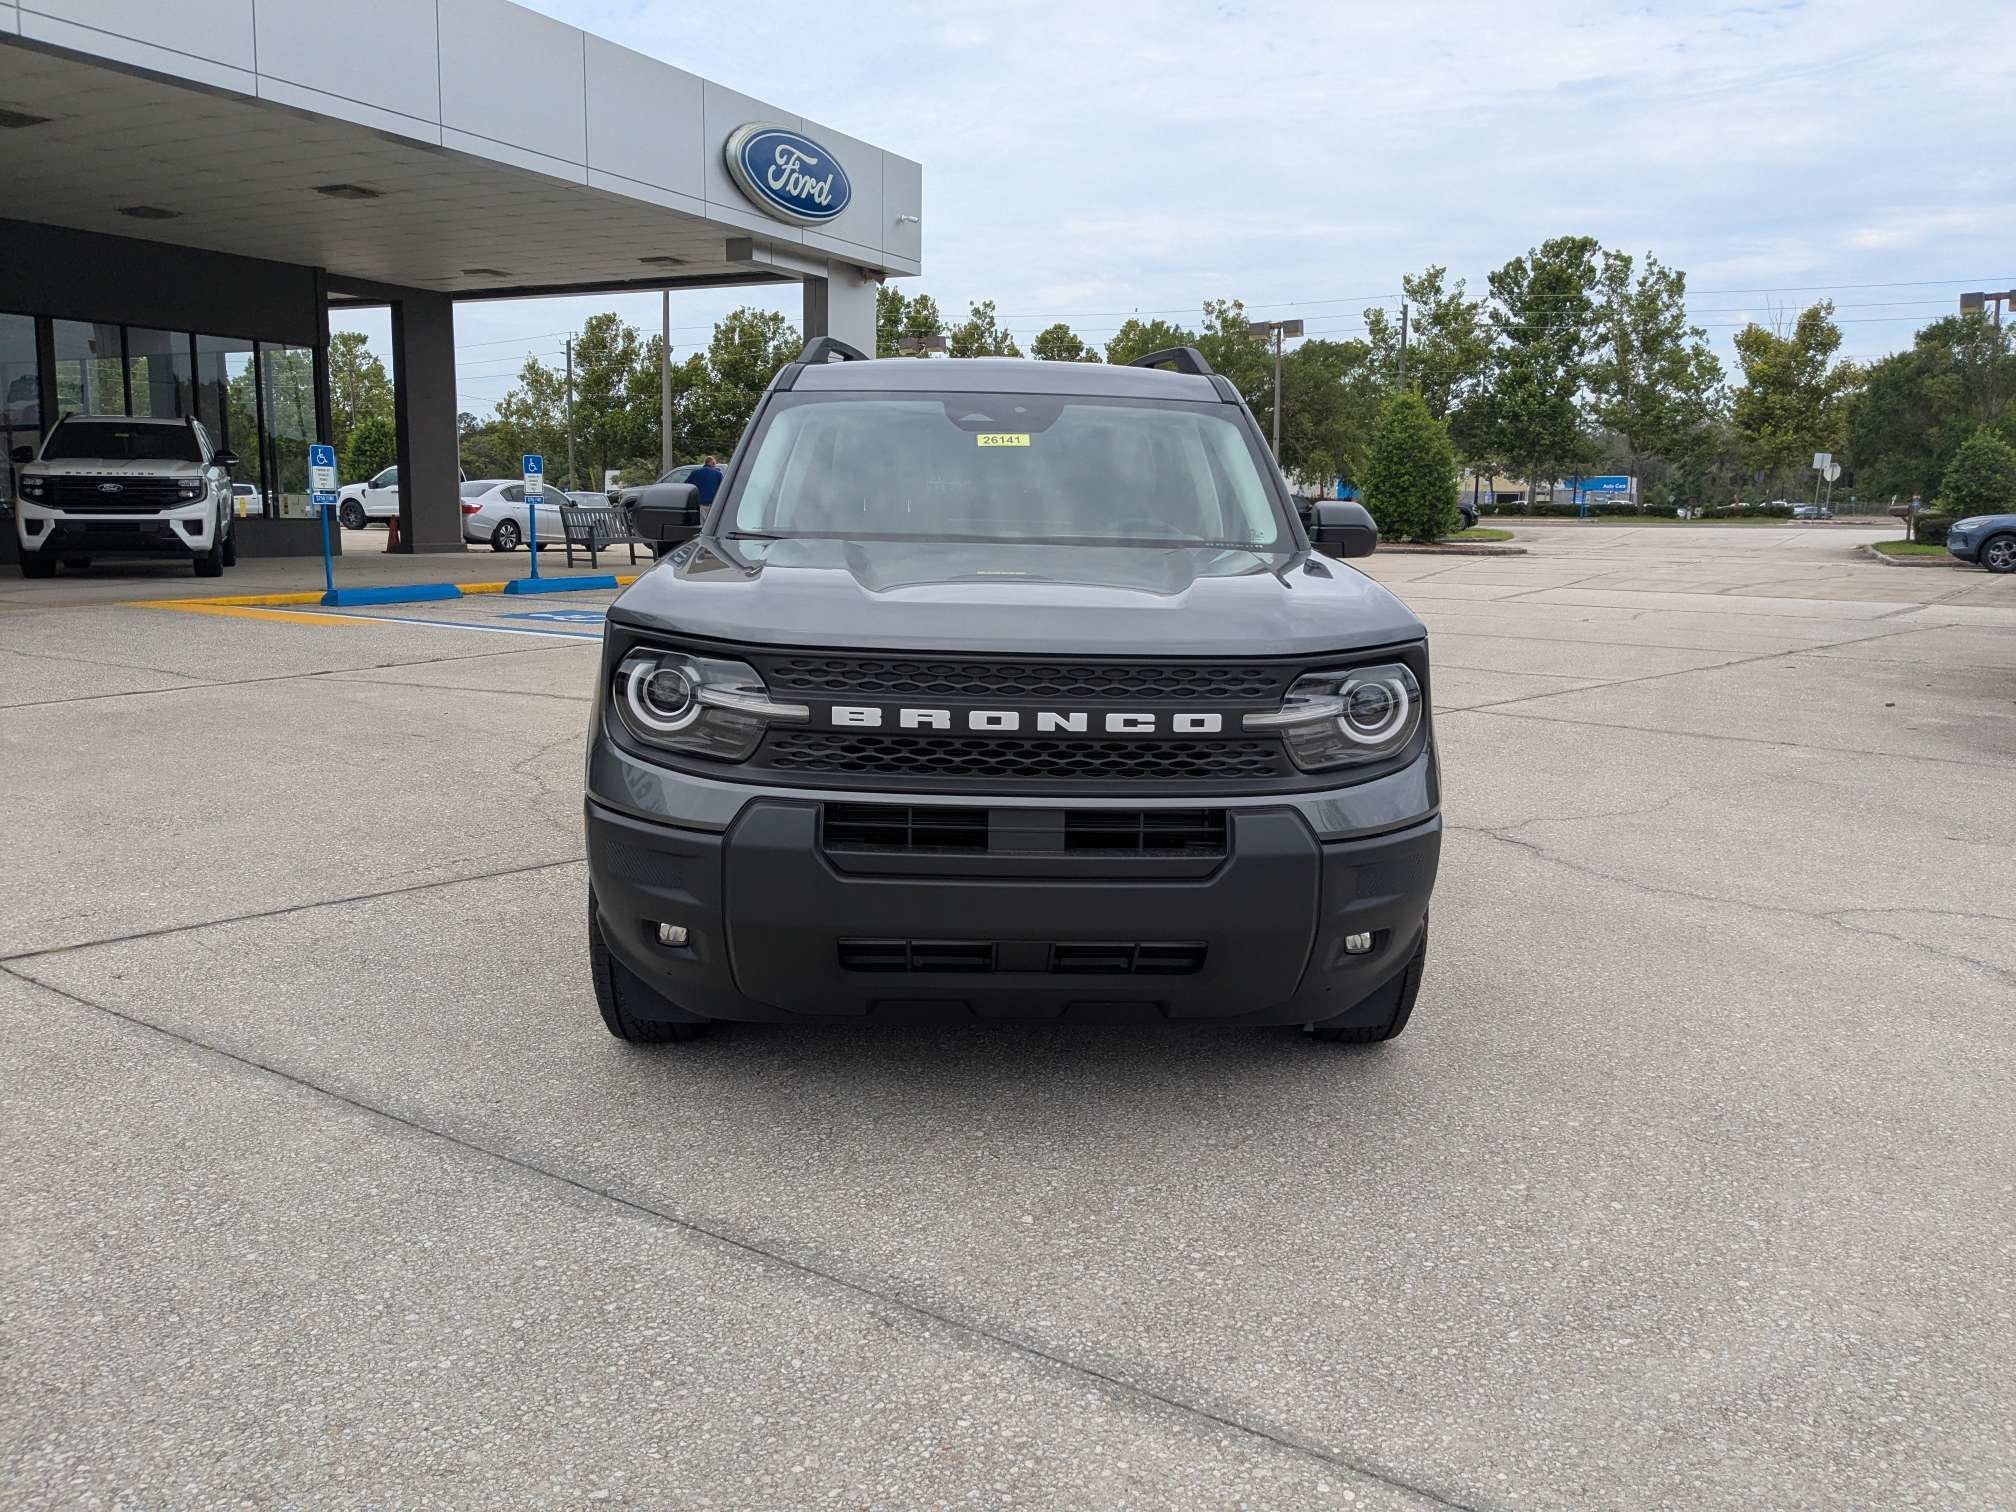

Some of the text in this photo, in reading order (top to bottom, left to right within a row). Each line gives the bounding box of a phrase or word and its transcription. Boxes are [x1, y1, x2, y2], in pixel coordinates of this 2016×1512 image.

[767, 144, 833, 206] Ford
[983, 436, 1021, 444] 26141
[831, 706, 1222, 733] BRONCO
